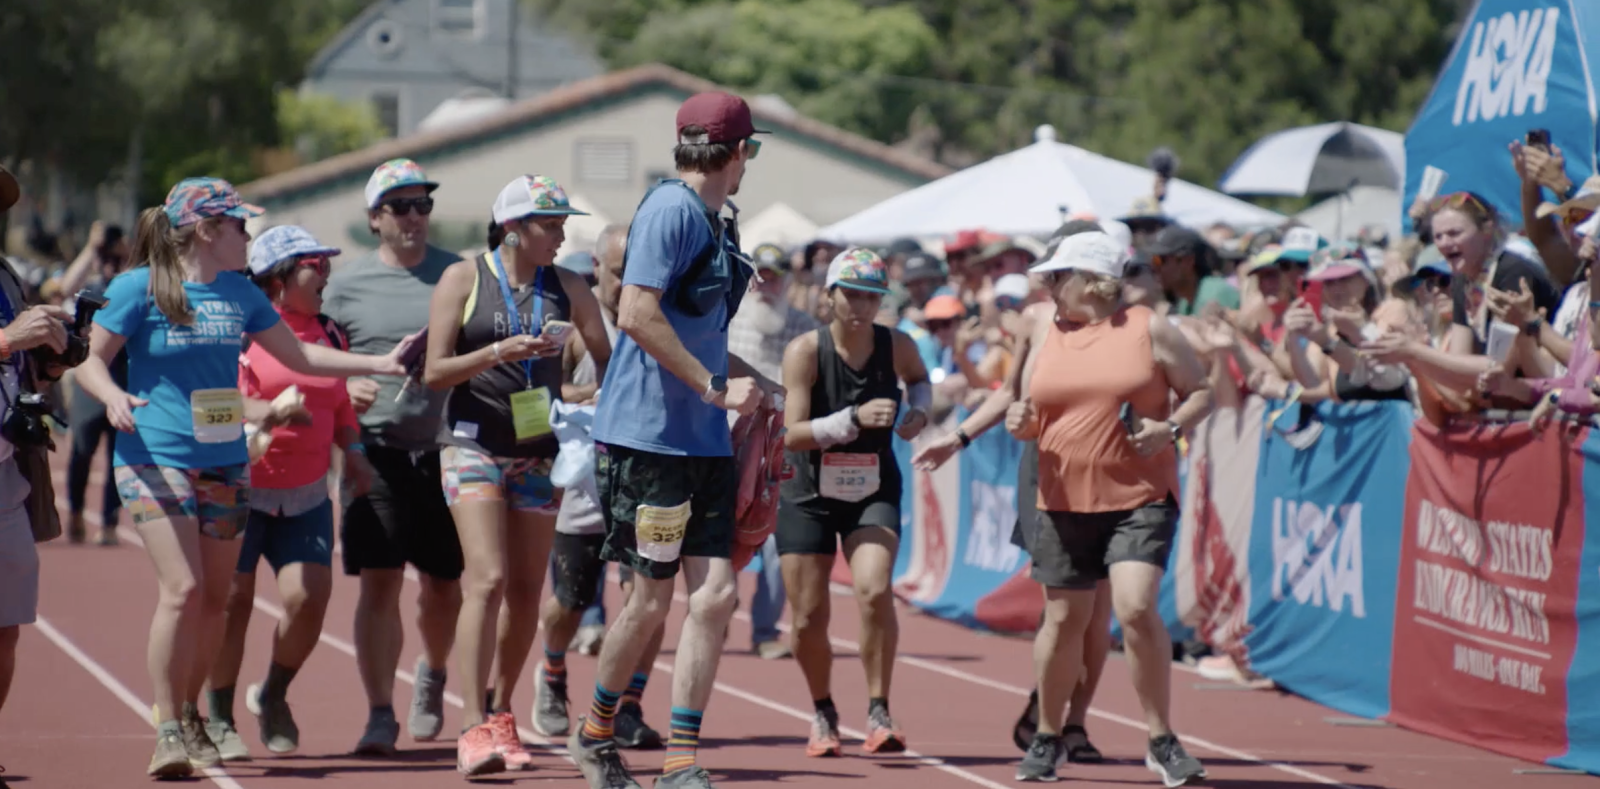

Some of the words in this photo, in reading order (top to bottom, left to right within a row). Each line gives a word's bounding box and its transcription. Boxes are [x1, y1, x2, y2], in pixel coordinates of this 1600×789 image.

[1452, 7, 1560, 126] HOKA
[203, 301, 244, 315] TRAIL
[206, 413, 233, 424] 323
[834, 476, 865, 486] 323
[652, 530, 683, 543] 323
[1272, 496, 1366, 618] HOKA
[1486, 520, 1553, 582] STATES
